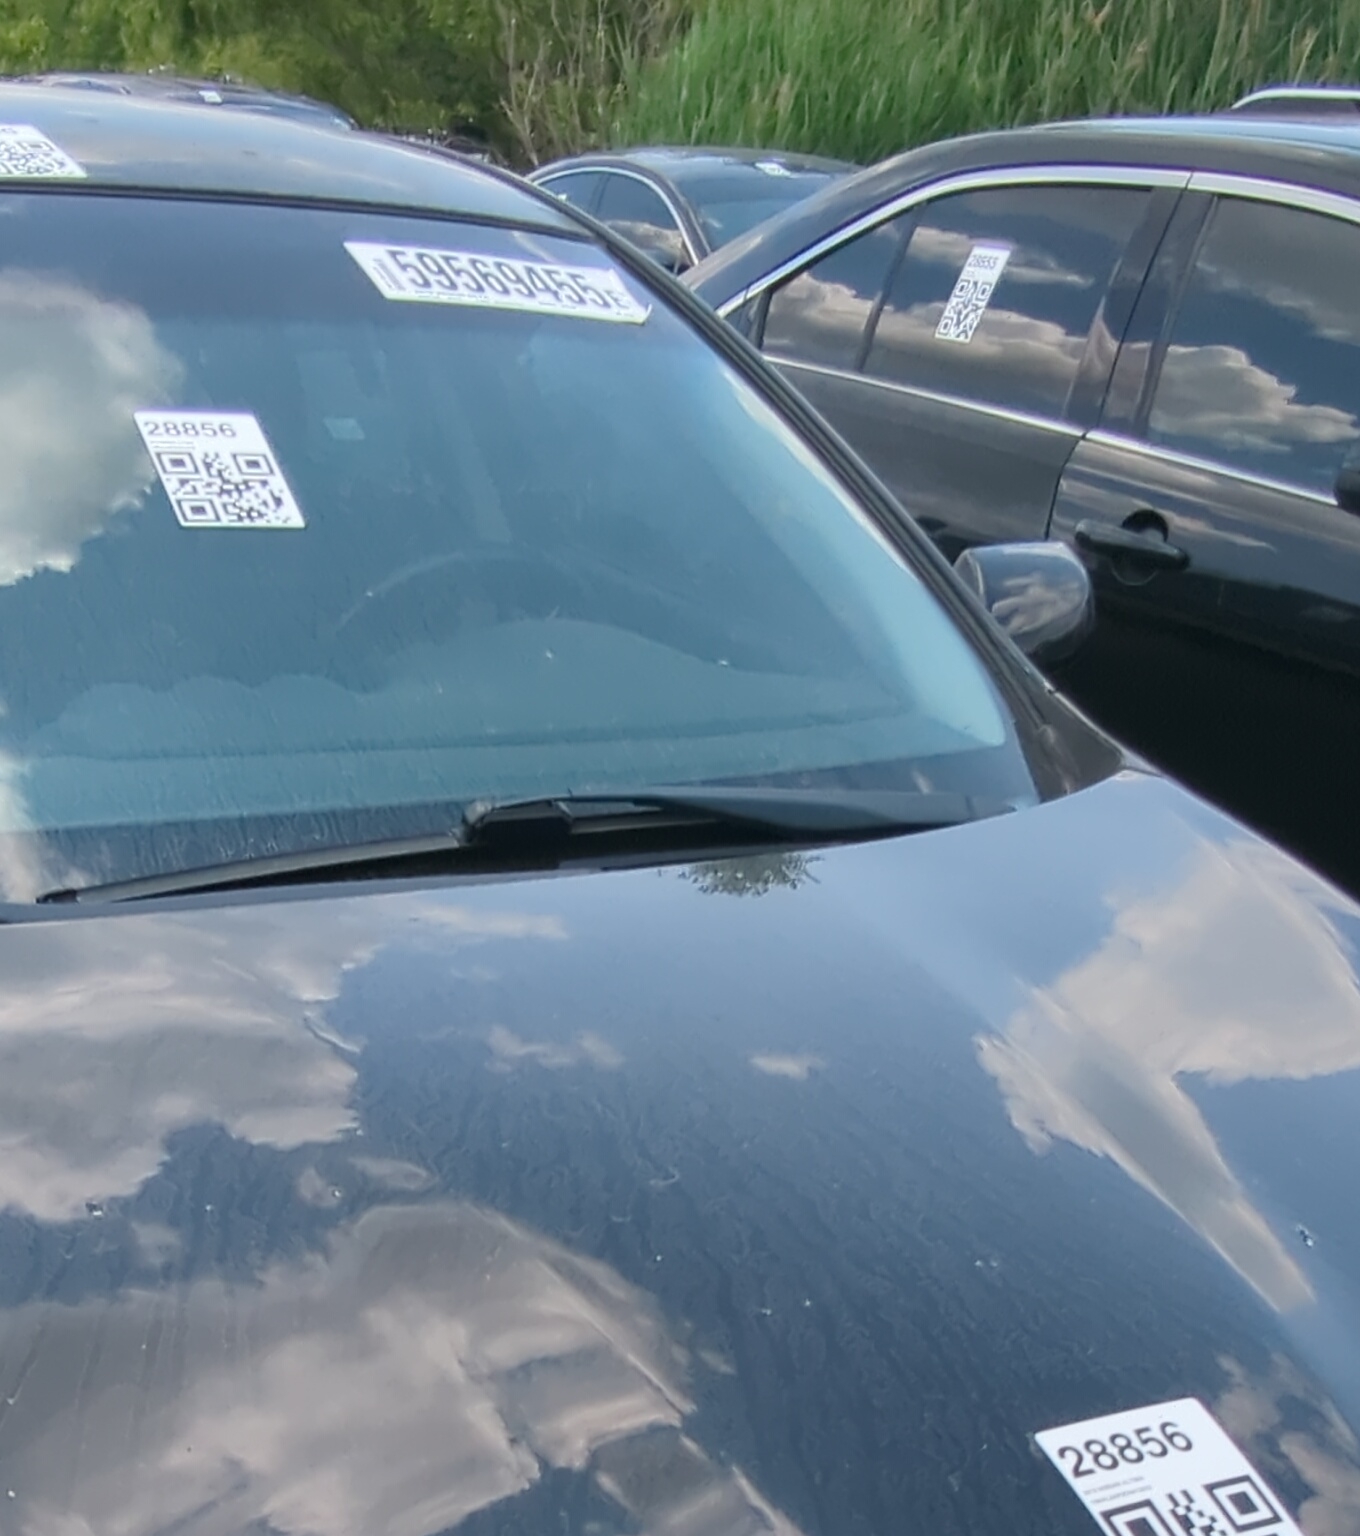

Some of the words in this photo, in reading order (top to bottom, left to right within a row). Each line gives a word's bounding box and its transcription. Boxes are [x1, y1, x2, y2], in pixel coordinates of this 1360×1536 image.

[386, 249, 613, 310] 59569455
[143, 421, 238, 438] 28856
[1057, 1421, 1193, 1479] 28856
